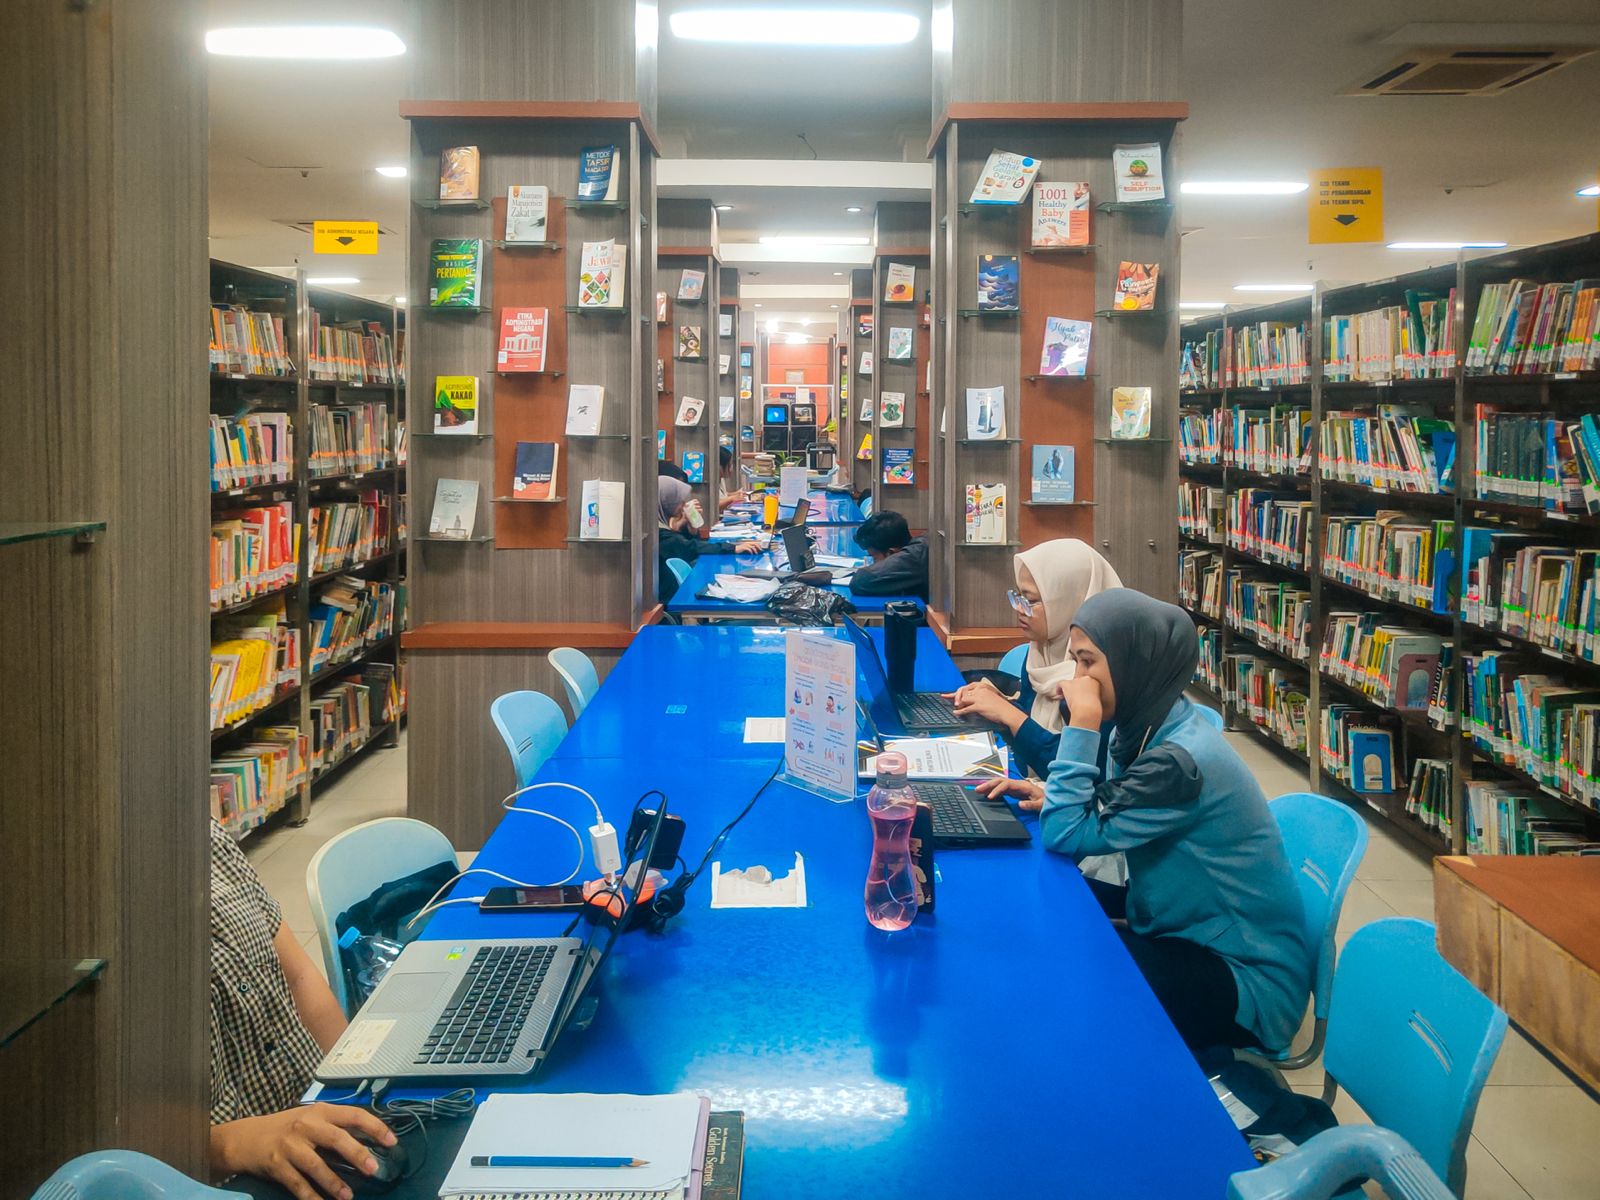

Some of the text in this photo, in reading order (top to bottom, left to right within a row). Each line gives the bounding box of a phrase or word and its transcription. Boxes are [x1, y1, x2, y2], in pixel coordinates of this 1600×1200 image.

[1039, 189, 1068, 200] 1001
[1038, 200, 1068, 209] Healthy
[511, 205, 531, 218] Zakat
[1041, 208, 1065, 219] Baby
[1038, 216, 1068, 227] Answers
[450, 391, 473, 400] KAKAO
[703, 1127, 722, 1186] Golden Secrets
